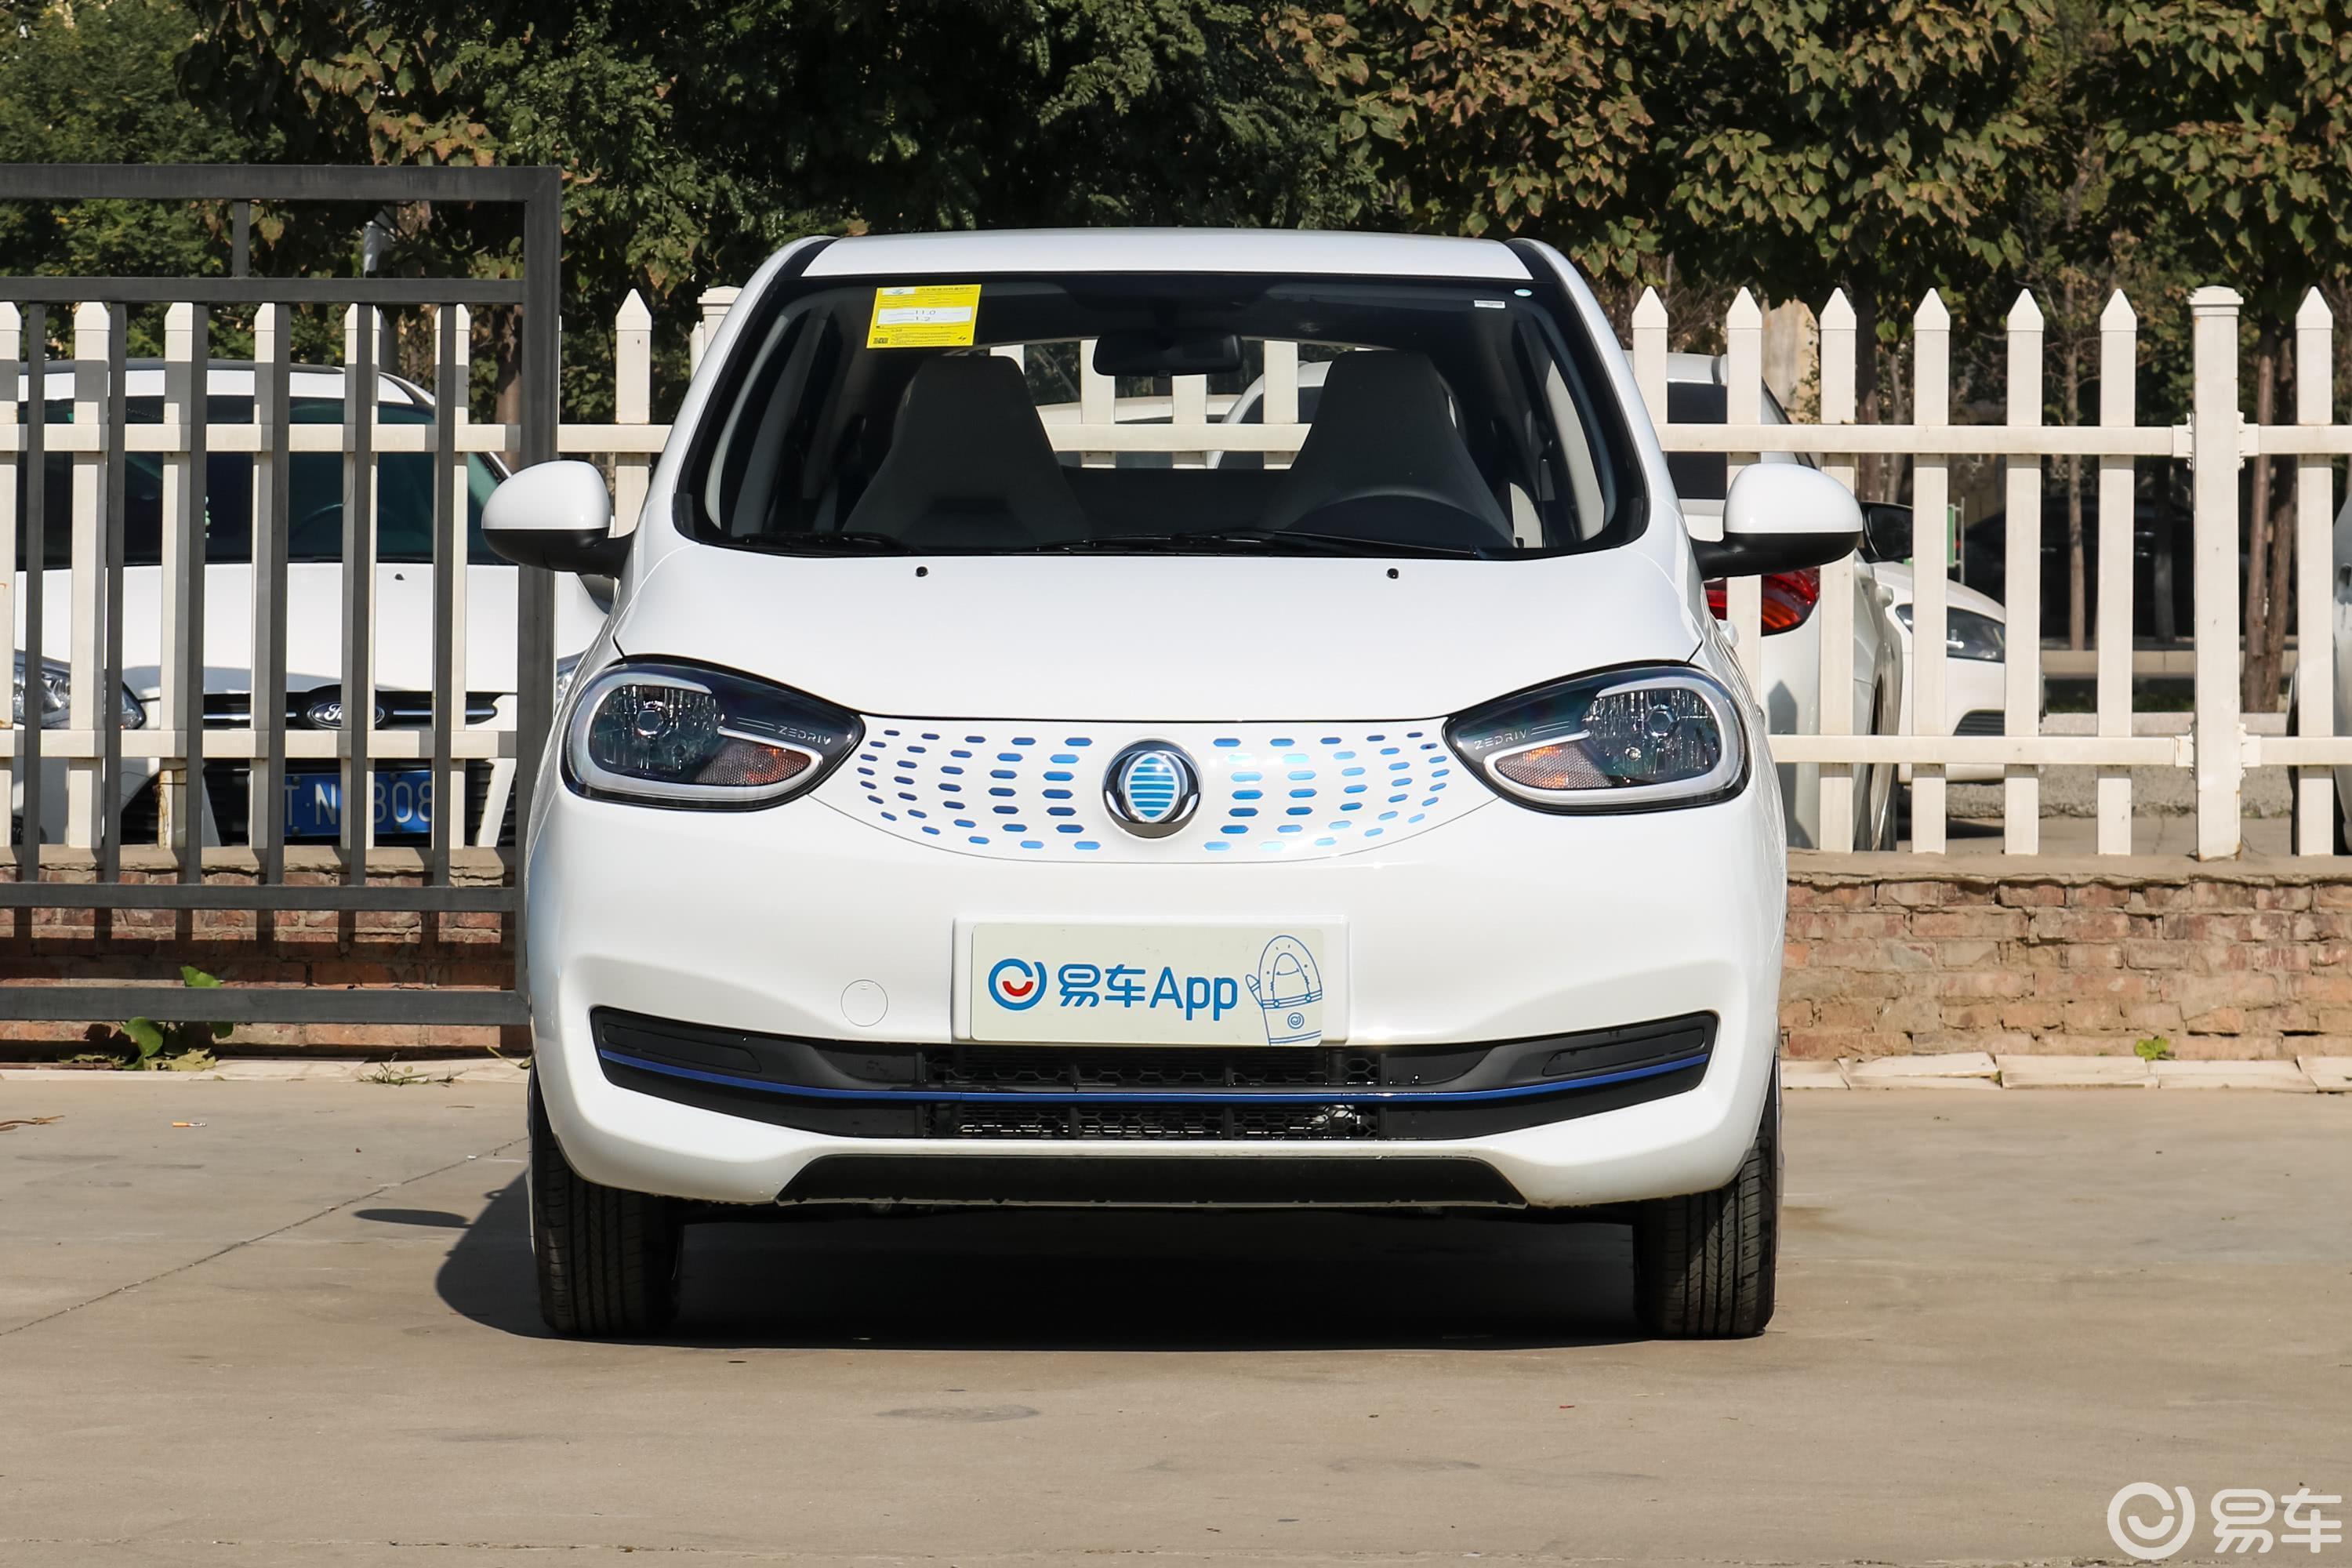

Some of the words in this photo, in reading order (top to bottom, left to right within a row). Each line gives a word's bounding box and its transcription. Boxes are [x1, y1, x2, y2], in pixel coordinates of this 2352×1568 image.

[779, 725, 831, 745] ZEDRIV
[1474, 729, 1526, 750] ZEDRIV
[1058, 964, 1238, 1021] 易车App
